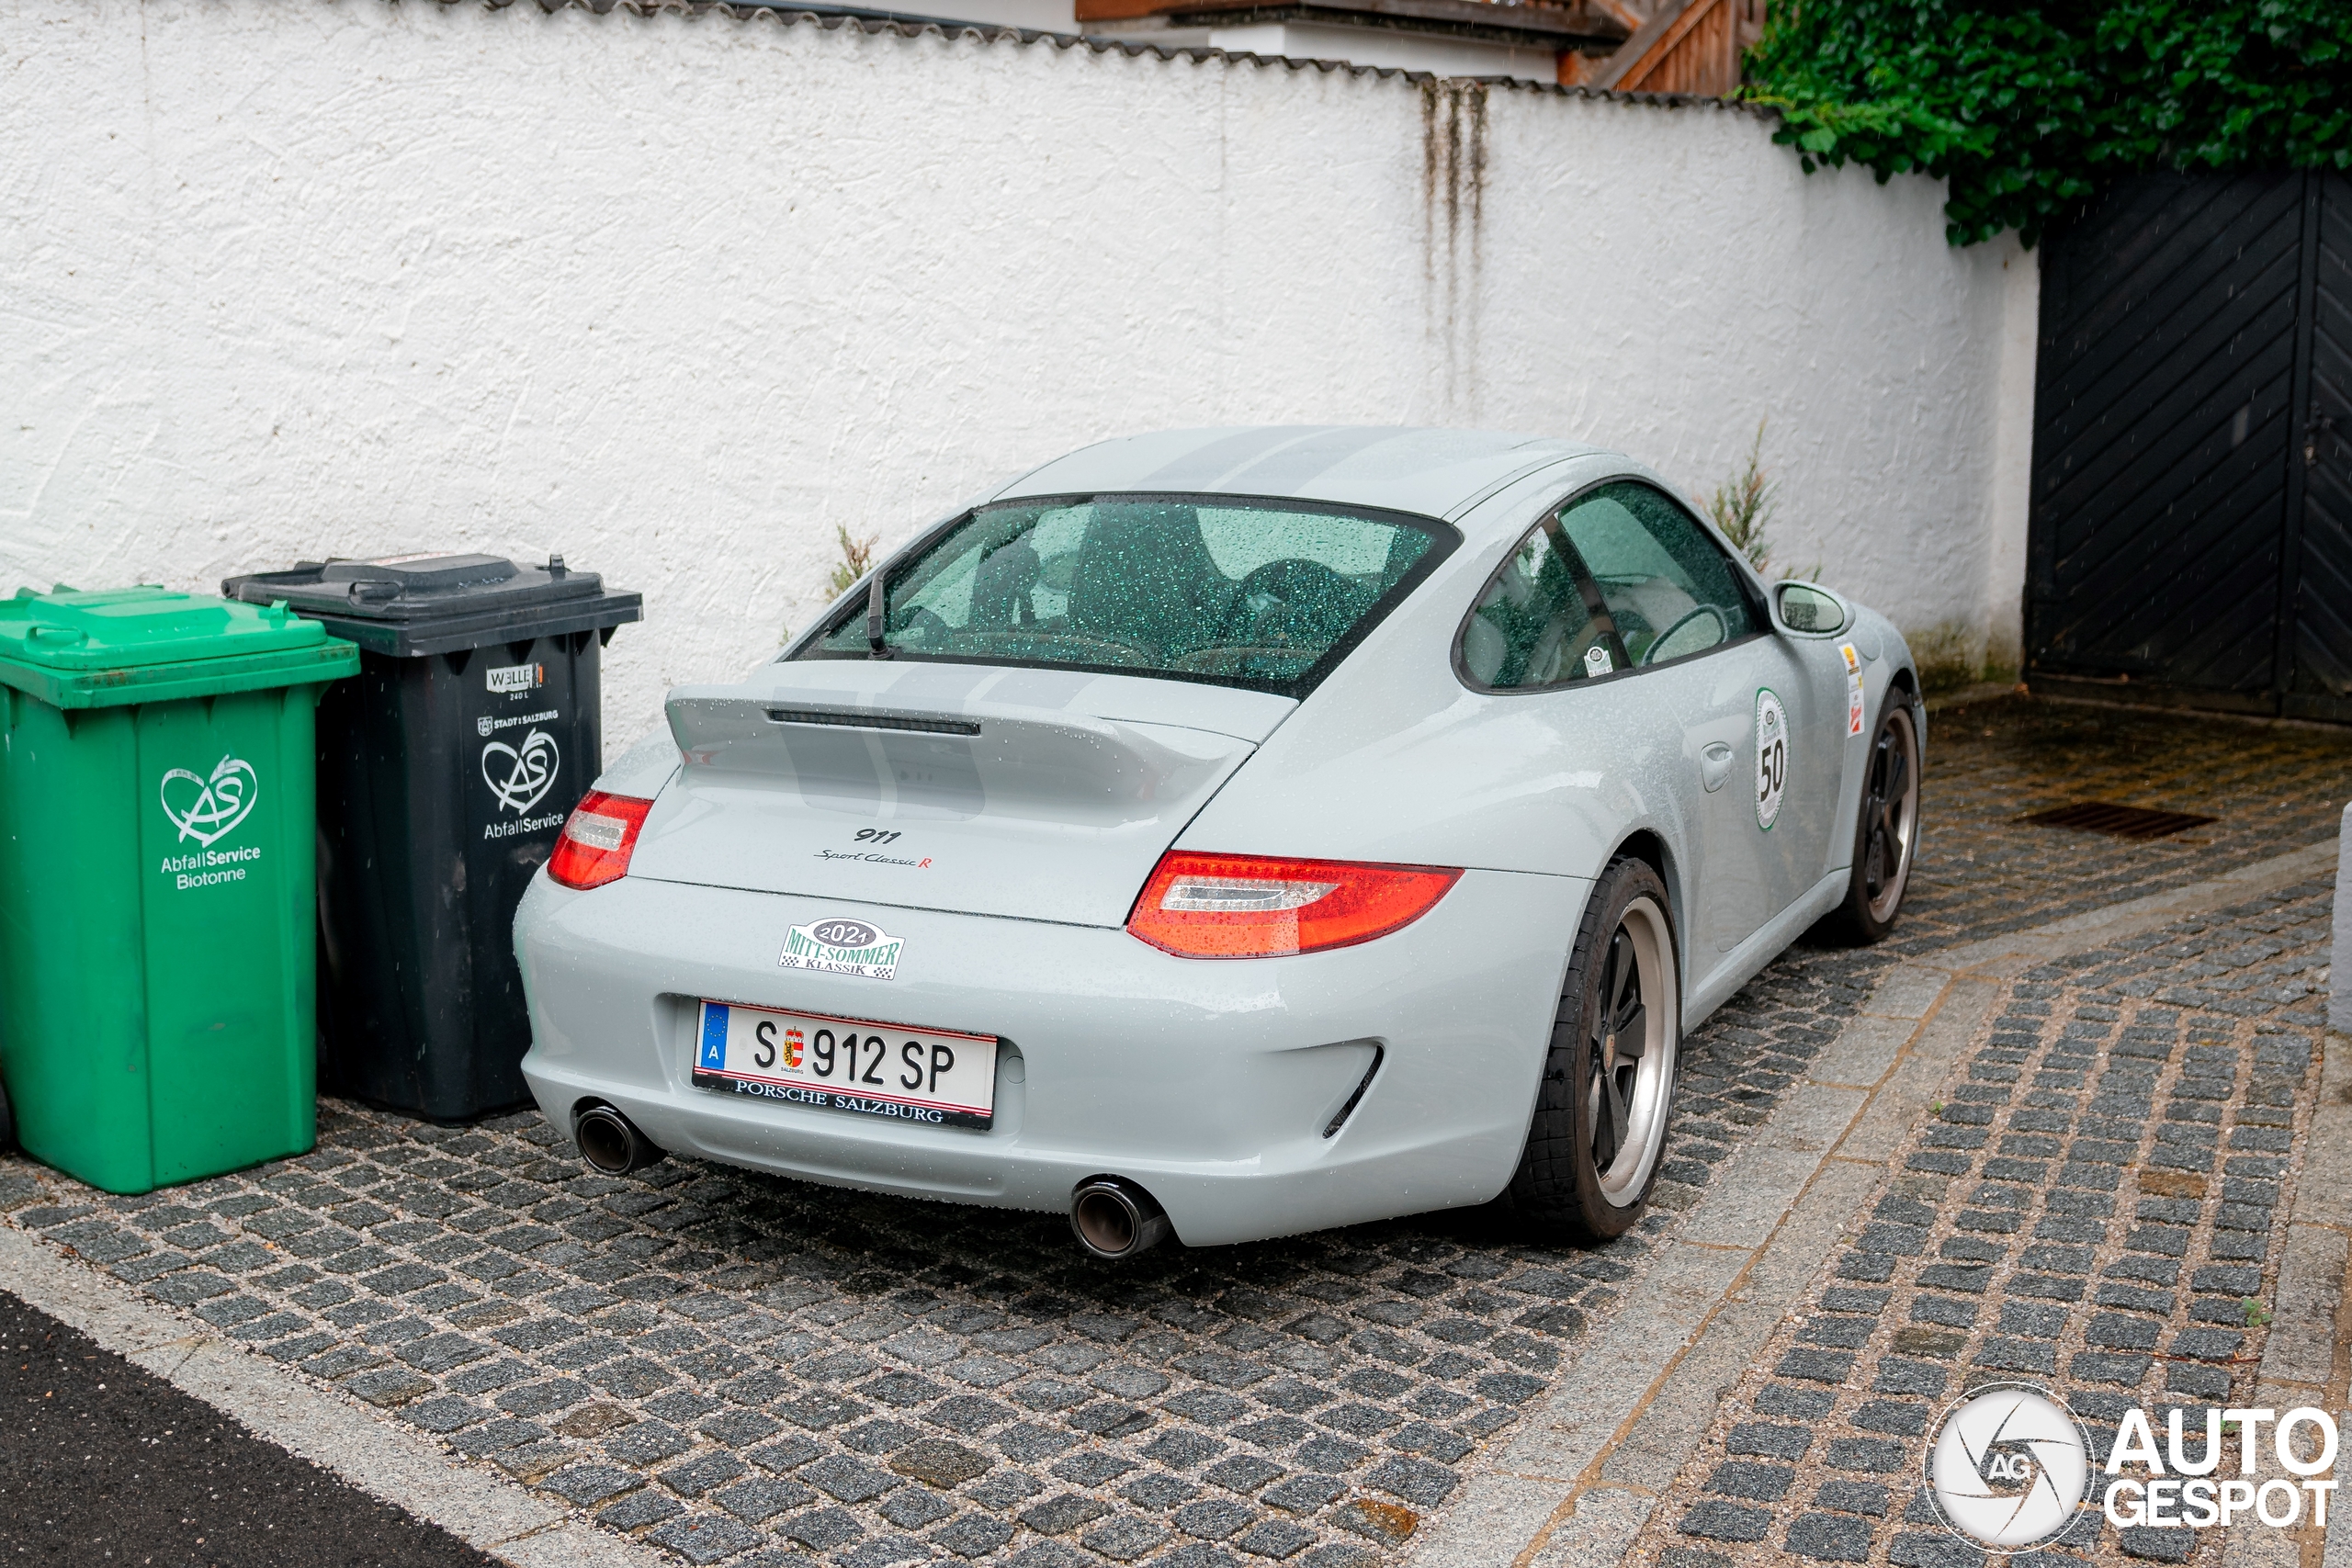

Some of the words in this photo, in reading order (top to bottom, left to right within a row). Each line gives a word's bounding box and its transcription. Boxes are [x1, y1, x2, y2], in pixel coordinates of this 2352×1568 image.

[509, 692, 523, 701] 240
[494, 716, 517, 729] STADT
[522, 709, 559, 725] SALZBURG
[499, 748, 548, 812] AS
[1760, 739, 1784, 802] 50
[178, 776, 243, 844] AS
[484, 812, 564, 840] AbfallService
[854, 828, 902, 844] 911
[161, 845, 261, 874] AbfallService
[813, 849, 865, 861] Sport
[864, 853, 917, 866] Classic
[917, 857, 933, 869] R
[176, 867, 246, 890] Biotonne
[819, 924, 868, 944] 2021
[785, 927, 900, 965] MITT-SOMMER
[805, 958, 868, 976] KLASSIK
[708, 1044, 719, 1061] A
[753, 1021, 778, 1069] S
[812, 1029, 887, 1086] 912
[899, 1040, 955, 1093] SP
[780, 1066, 804, 1075] SALZBURG
[735, 1079, 828, 1106] PORSCHE
[834, 1095, 944, 1123] SALZBURG
